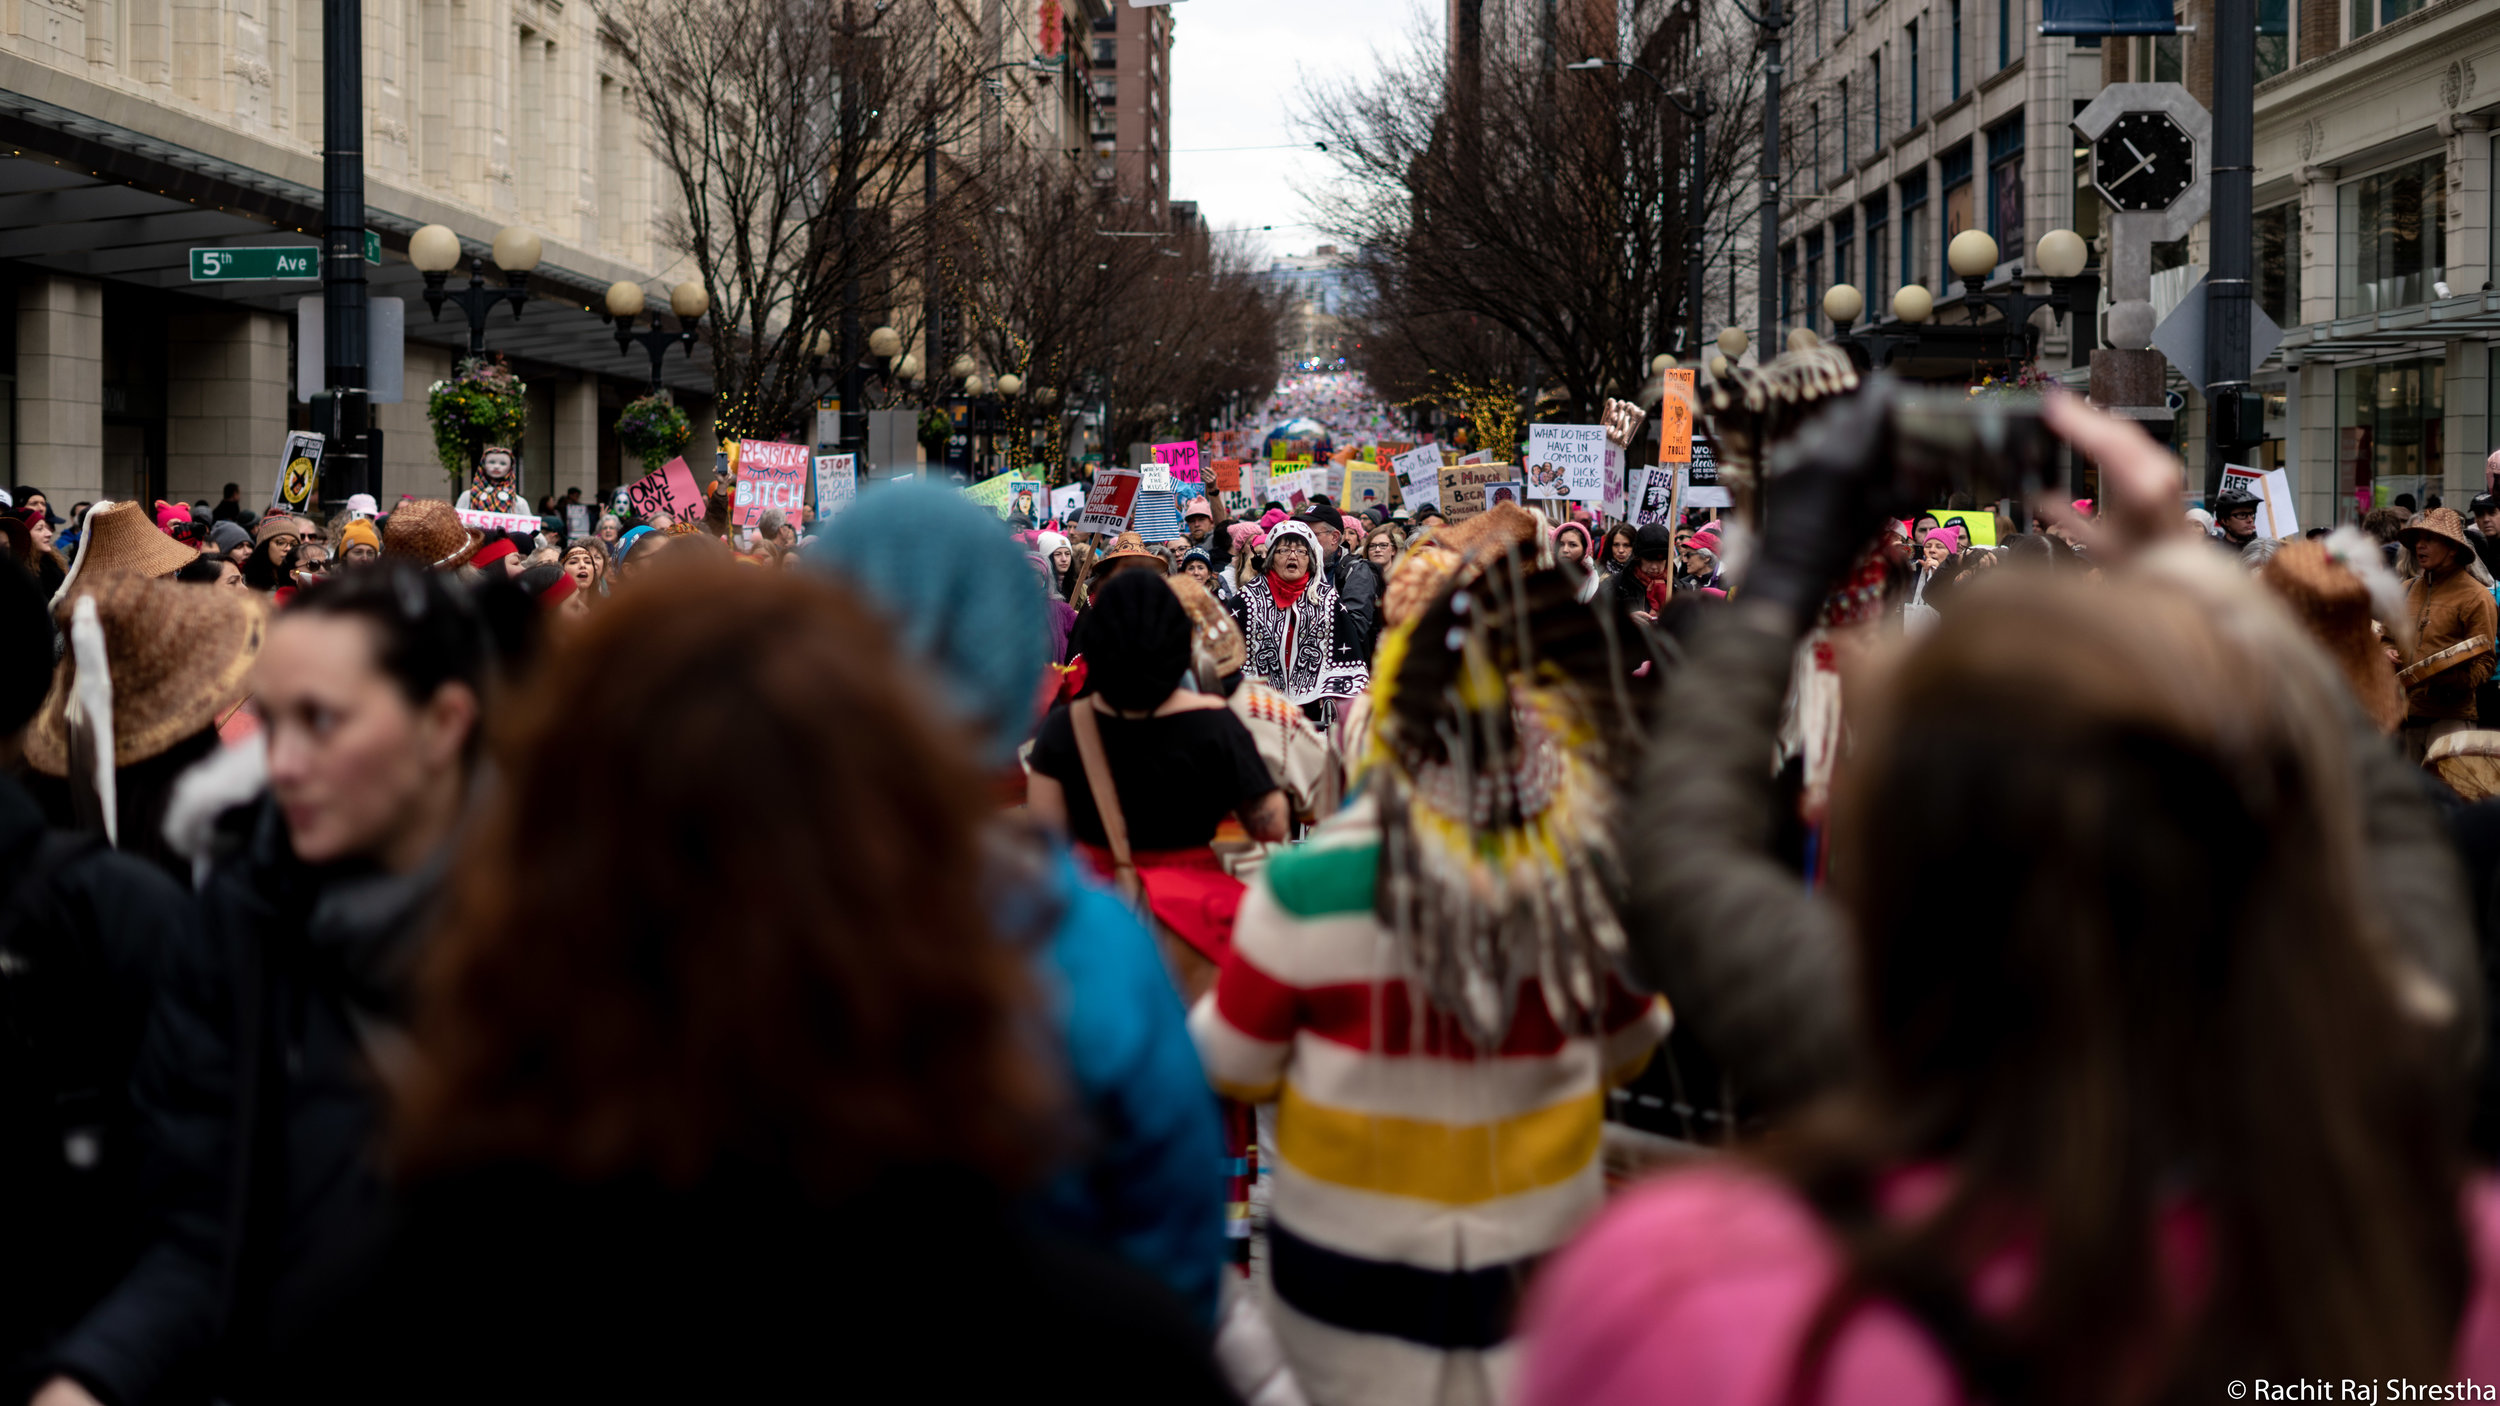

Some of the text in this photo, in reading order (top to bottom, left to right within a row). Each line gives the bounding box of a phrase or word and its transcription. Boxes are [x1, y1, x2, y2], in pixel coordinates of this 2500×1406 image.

[202, 252, 307, 276] 5th Ave
[1680, 372, 1691, 382] NOT
[1534, 428, 1602, 441] WHAT DO THESE
[1547, 442, 1588, 453] HAVE IN
[820, 458, 851, 470] STOP
[1543, 452, 1598, 464] COMMON?
[630, 468, 668, 504] ONLY
[833, 479, 852, 489] OUR
[1099, 476, 1115, 485] MY
[1445, 474, 1456, 488] I
[1572, 478, 1600, 488] HEADS
[1649, 470, 1672, 490] REPEA
[736, 480, 803, 508] BITCH
[1012, 484, 1038, 492] FUTURE
[1095, 486, 1117, 495] BODY
[820, 489, 855, 502] RIGHTS
[1091, 494, 1108, 504] MY
[636, 486, 675, 518] LOVE
[1088, 504, 1119, 514] CHOICE
[1084, 514, 1122, 527] #METOO
